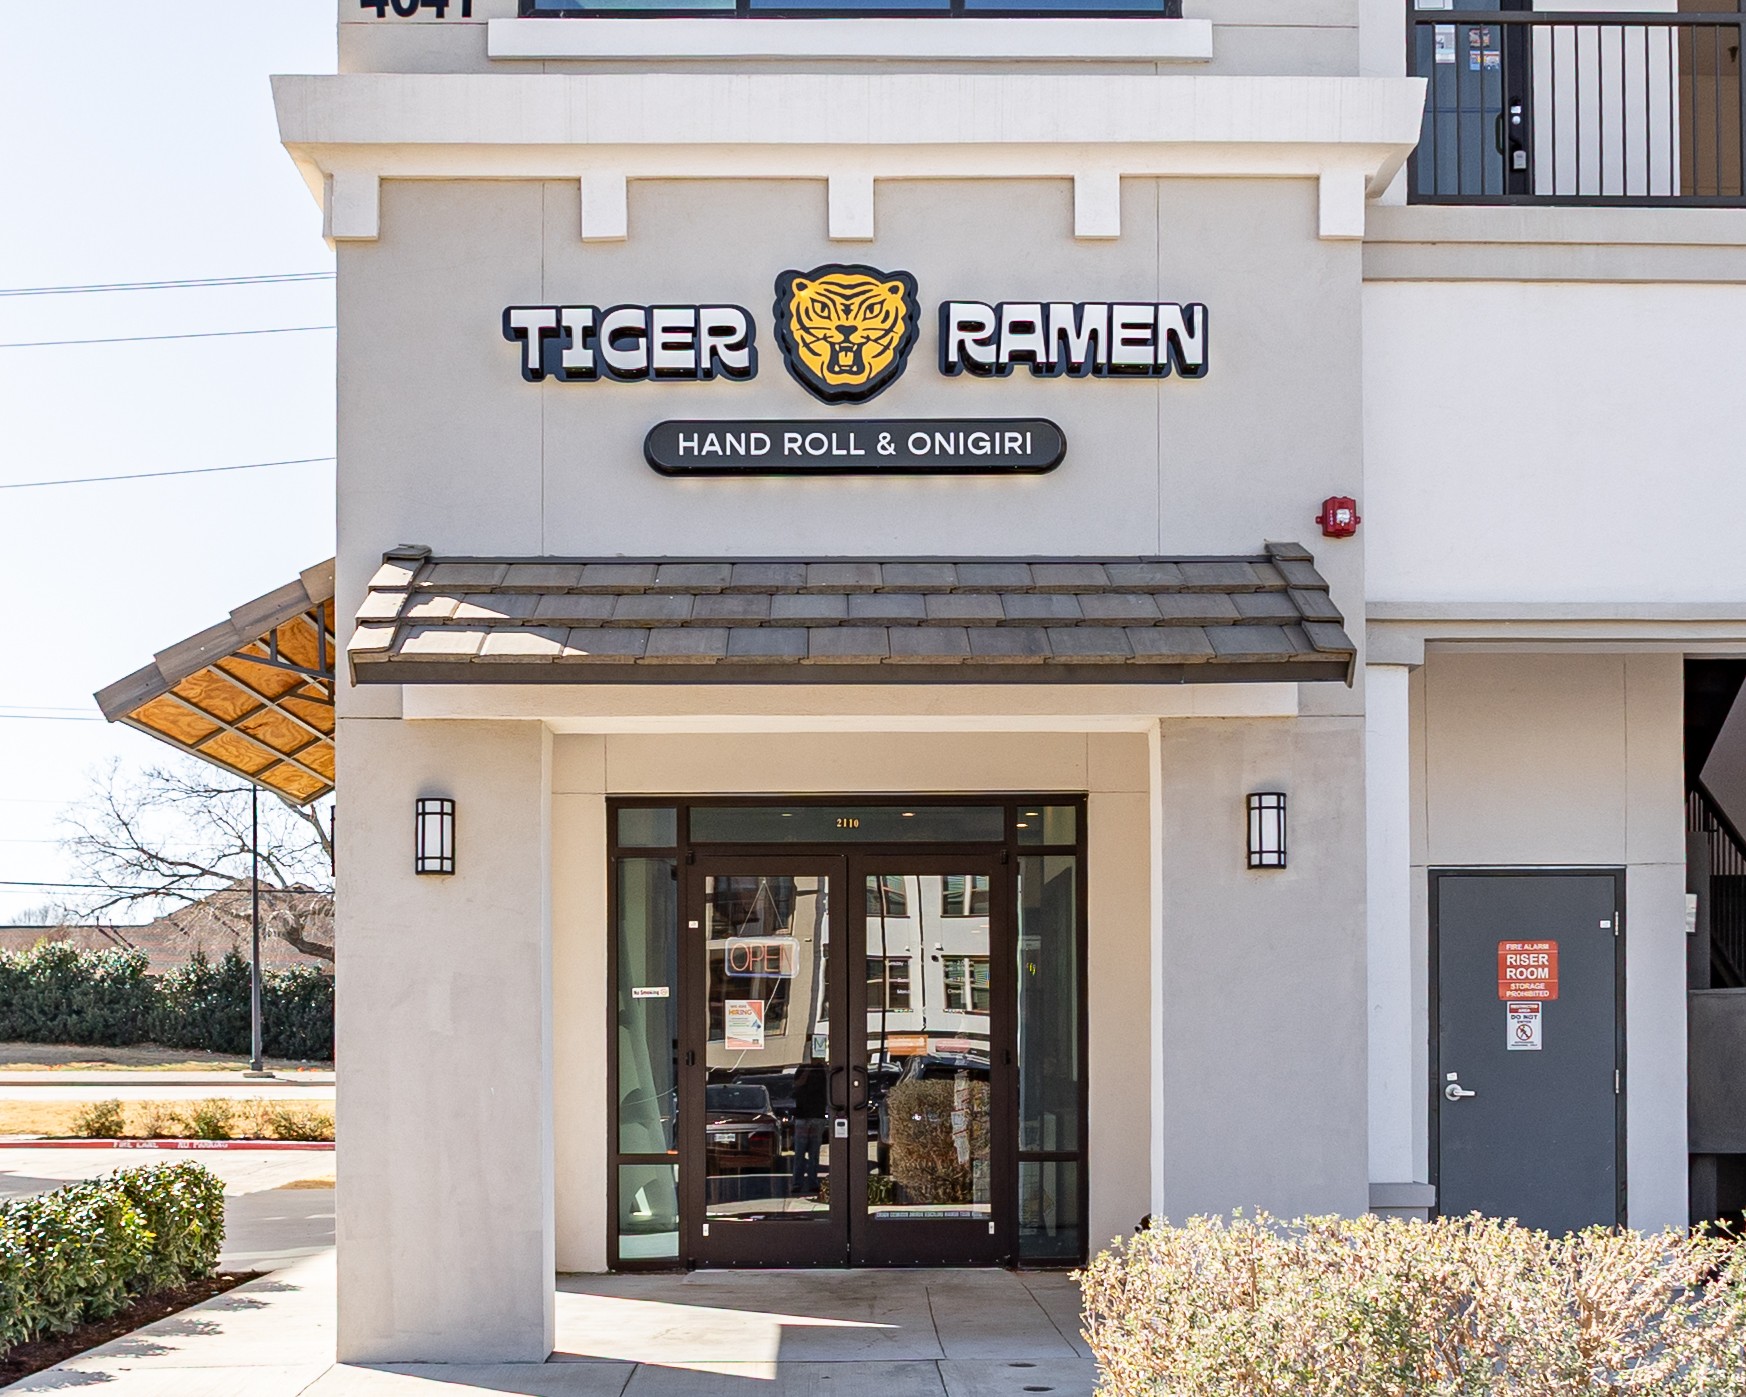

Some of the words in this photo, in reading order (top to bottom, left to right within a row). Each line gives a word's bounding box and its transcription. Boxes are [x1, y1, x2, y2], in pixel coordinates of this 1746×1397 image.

[507, 304, 753, 374] TIGER
[945, 301, 1206, 372] RAMEN
[677, 432, 772, 456] HAND
[783, 432, 866, 456] ROLL
[875, 432, 897, 456] &
[907, 431, 1034, 456] ONIGIRI
[836, 818, 859, 828] 2110
[730, 943, 794, 971] OPEN
[1506, 954, 1549, 966] RISER
[1506, 967, 1549, 980] ROOM
[1506, 990, 1550, 998] PROHIBITED
